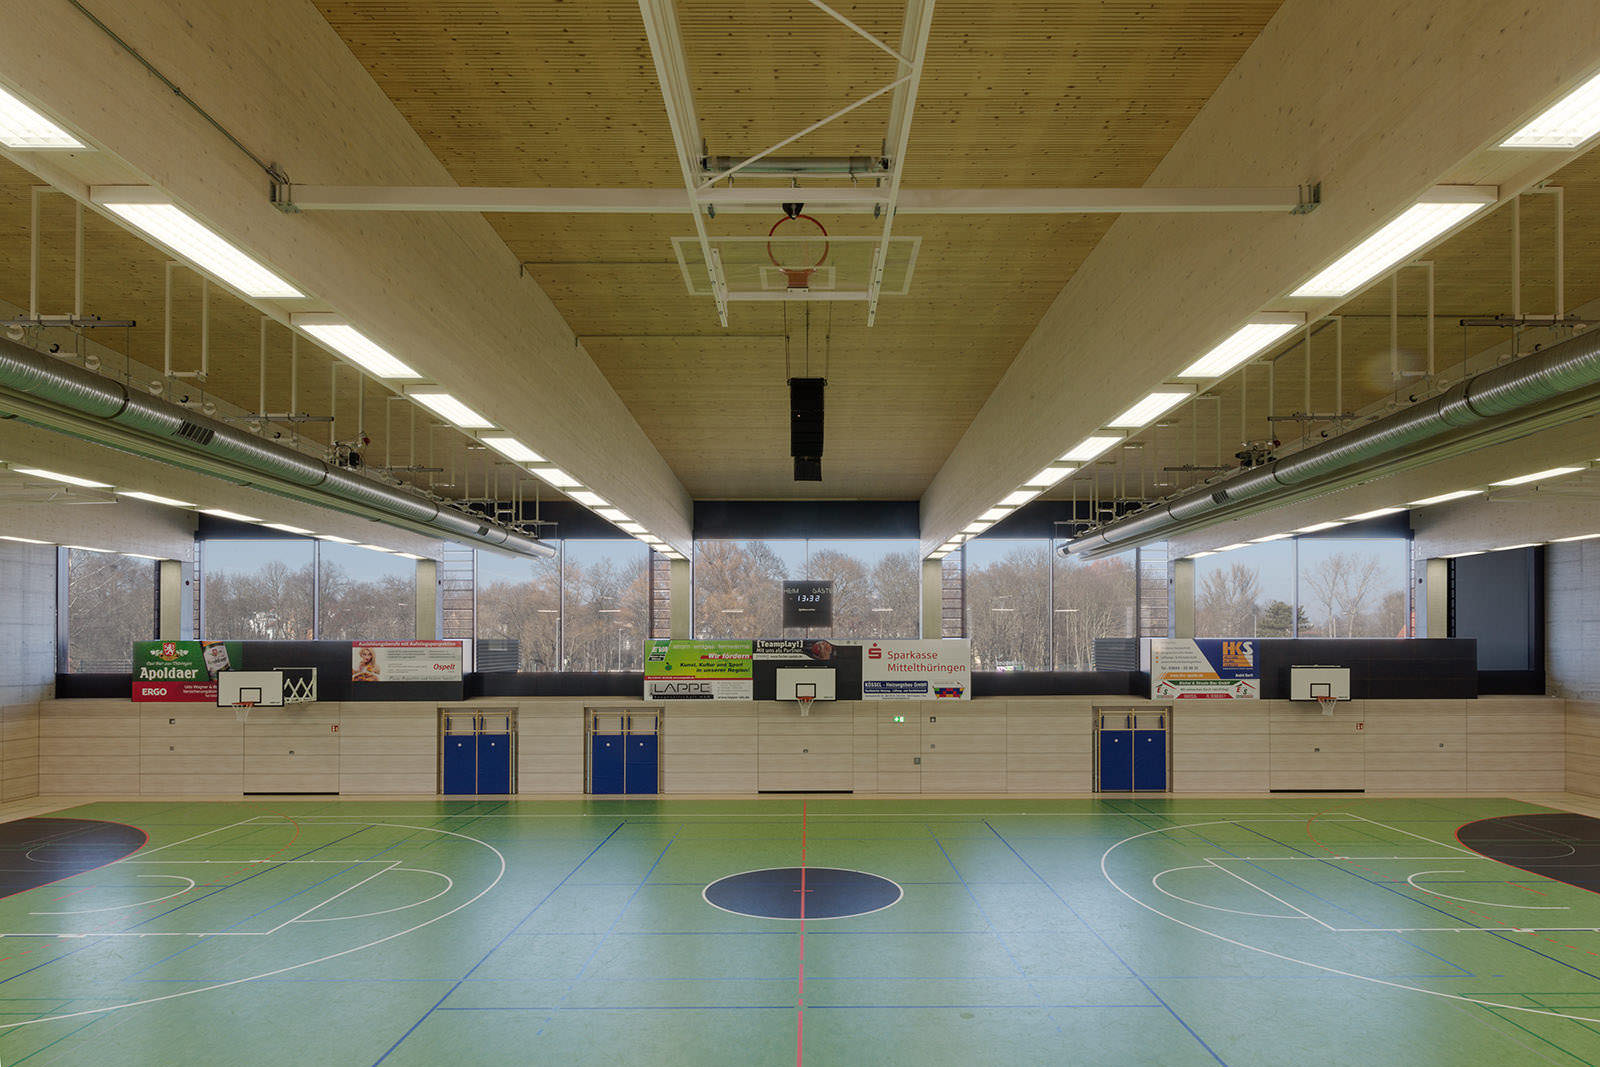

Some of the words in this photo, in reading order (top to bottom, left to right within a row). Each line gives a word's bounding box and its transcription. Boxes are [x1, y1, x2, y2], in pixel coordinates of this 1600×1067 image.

[1222, 641, 1253, 655] HKS
[887, 650, 938, 661] Sparkasse
[432, 663, 456, 672] Ospelt
[887, 663, 966, 674] Mittelthüringen
[139, 667, 199, 680] Apoldaer
[142, 688, 168, 696] ERGO
[654, 683, 711, 693] LAPPE
